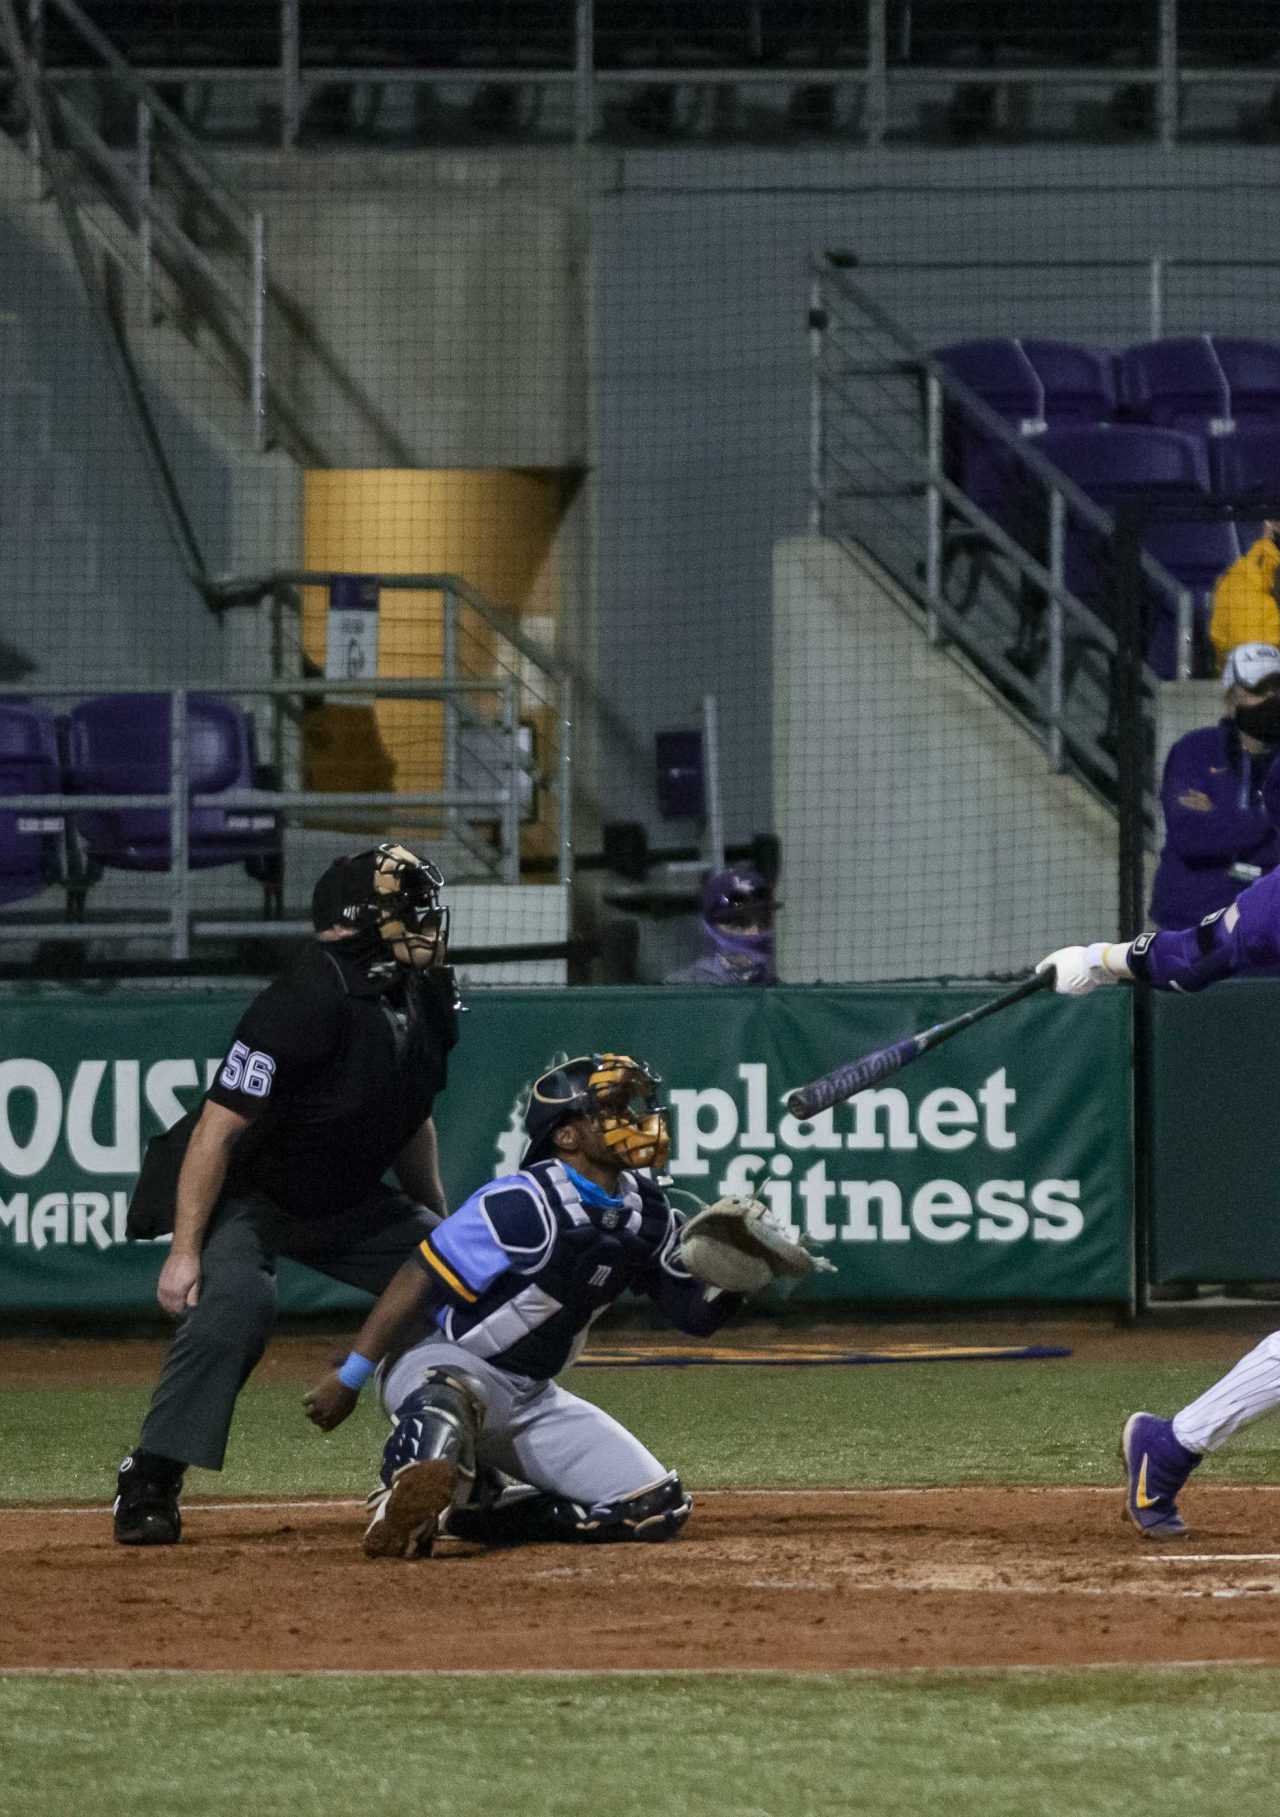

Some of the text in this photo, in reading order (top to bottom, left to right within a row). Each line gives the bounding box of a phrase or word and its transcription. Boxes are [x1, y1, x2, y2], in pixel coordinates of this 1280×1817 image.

[219, 1039, 277, 1098] 56
[669, 1063, 1017, 1175] planet
[718, 1153, 1085, 1242] fitness
